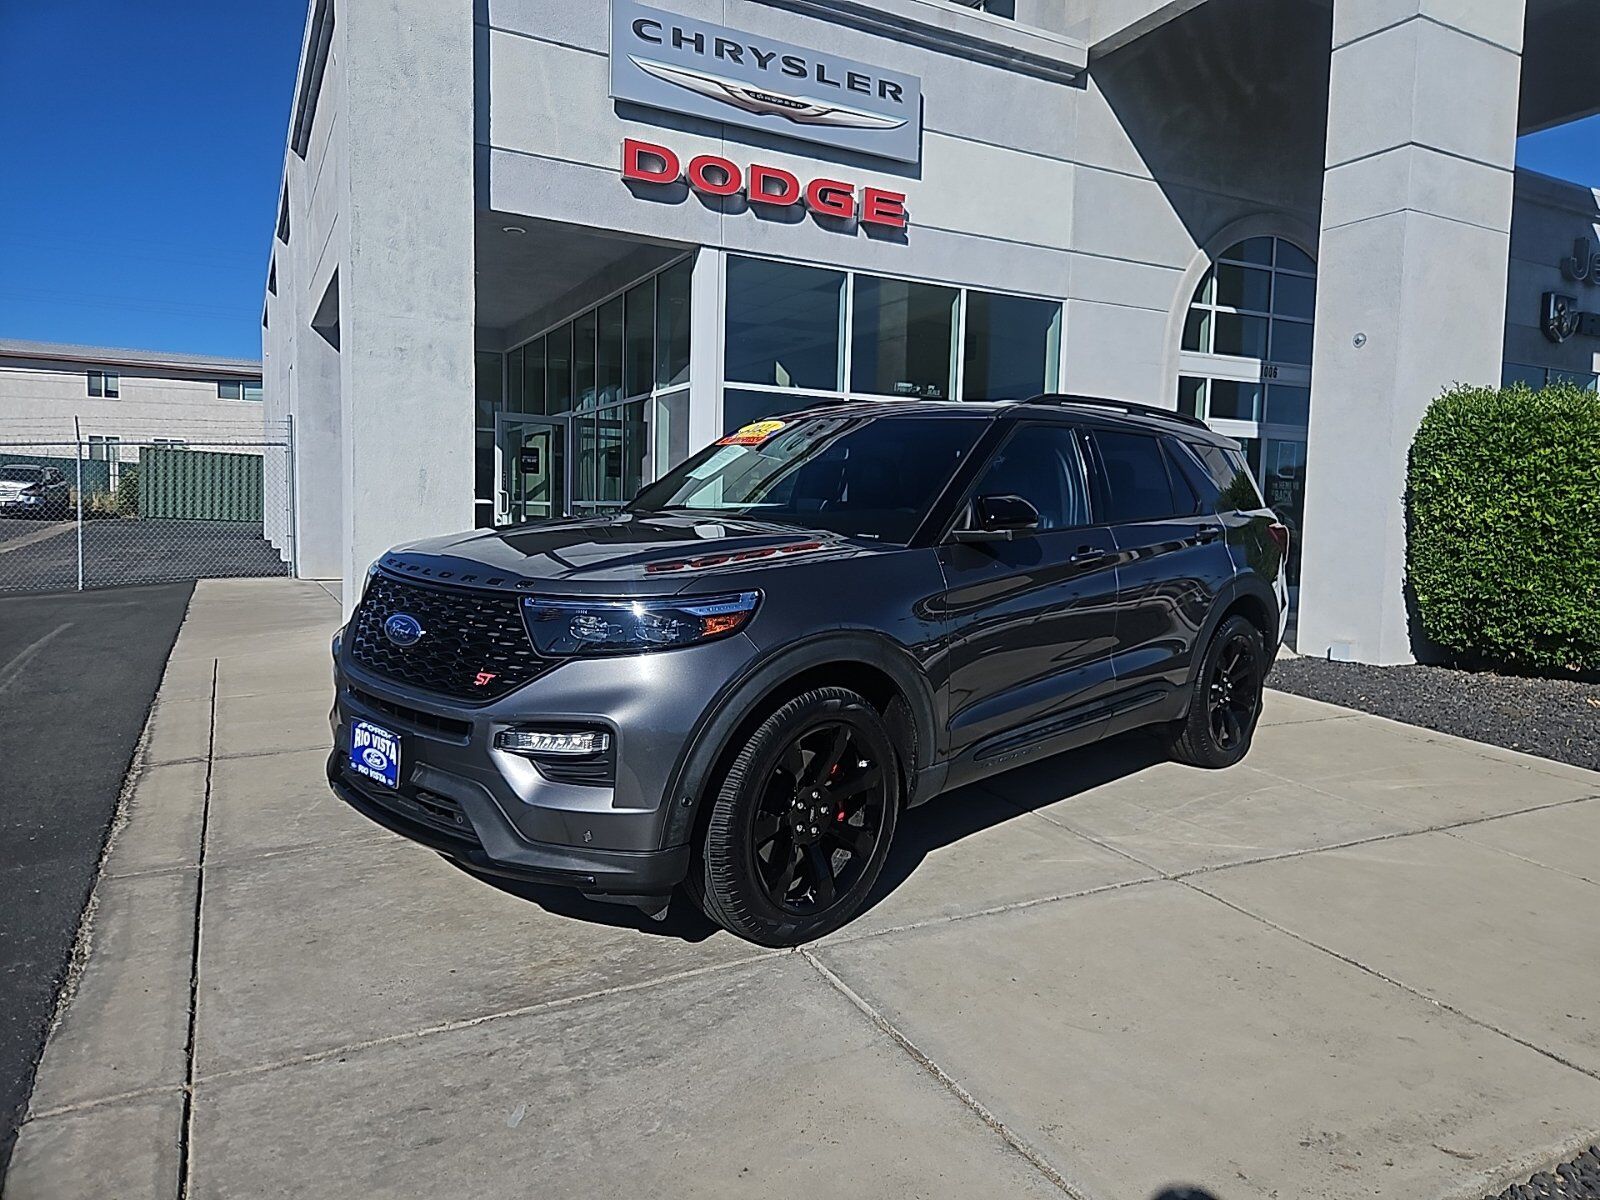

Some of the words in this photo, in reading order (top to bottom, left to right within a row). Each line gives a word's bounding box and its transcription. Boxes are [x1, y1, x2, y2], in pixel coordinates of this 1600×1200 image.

[632, 19, 904, 103] CHRYSLER
[621, 138, 906, 227] DODGE
[386, 558, 535, 589] EXPLORER
[473, 672, 496, 686] ST
[354, 728, 370, 748] RIO
[372, 734, 397, 766] VISTA
[358, 764, 369, 776] RIO
[370, 769, 387, 784] VISTA
